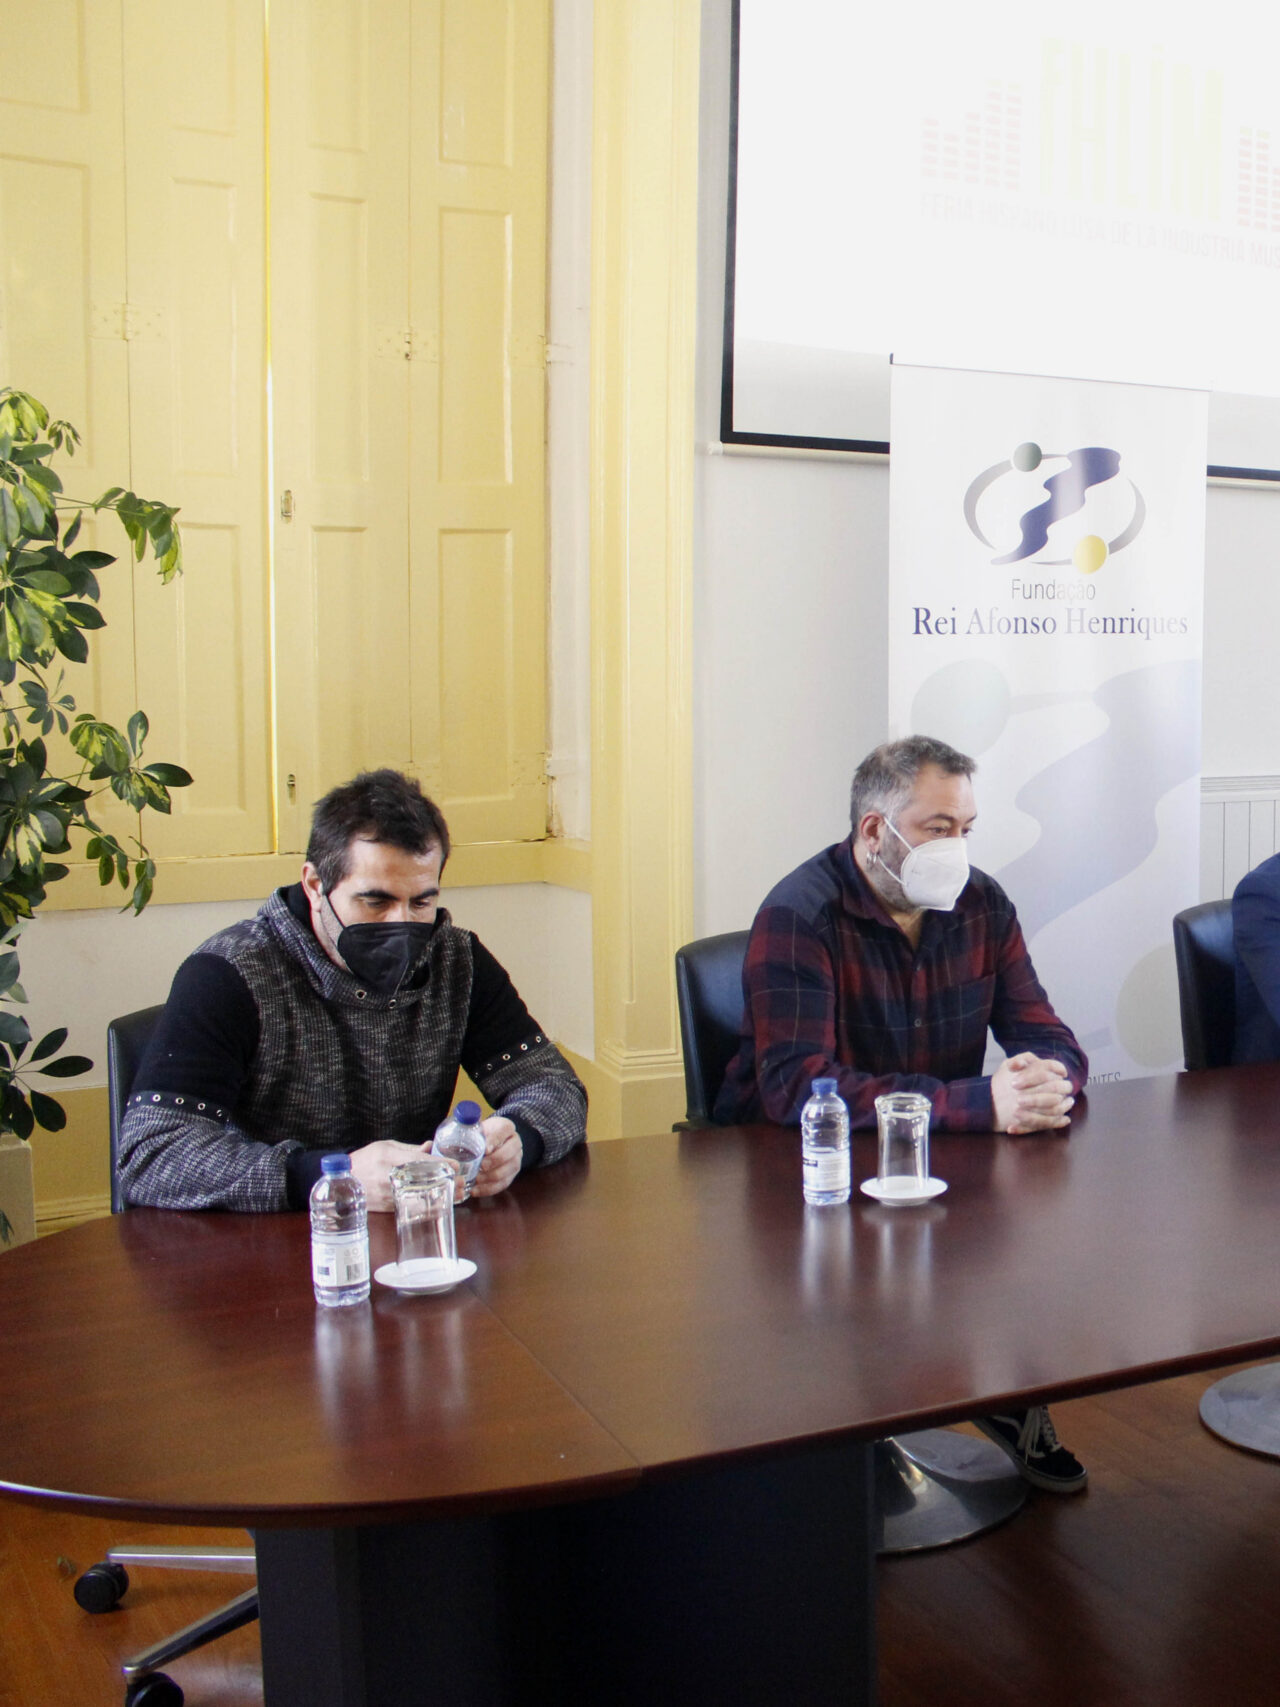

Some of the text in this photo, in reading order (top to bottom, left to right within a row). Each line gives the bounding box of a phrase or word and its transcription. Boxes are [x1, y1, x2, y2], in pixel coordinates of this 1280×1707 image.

[1011, 579, 1096, 602] Fundação
[912, 606, 1188, 640] Rei Afonso Henriques
